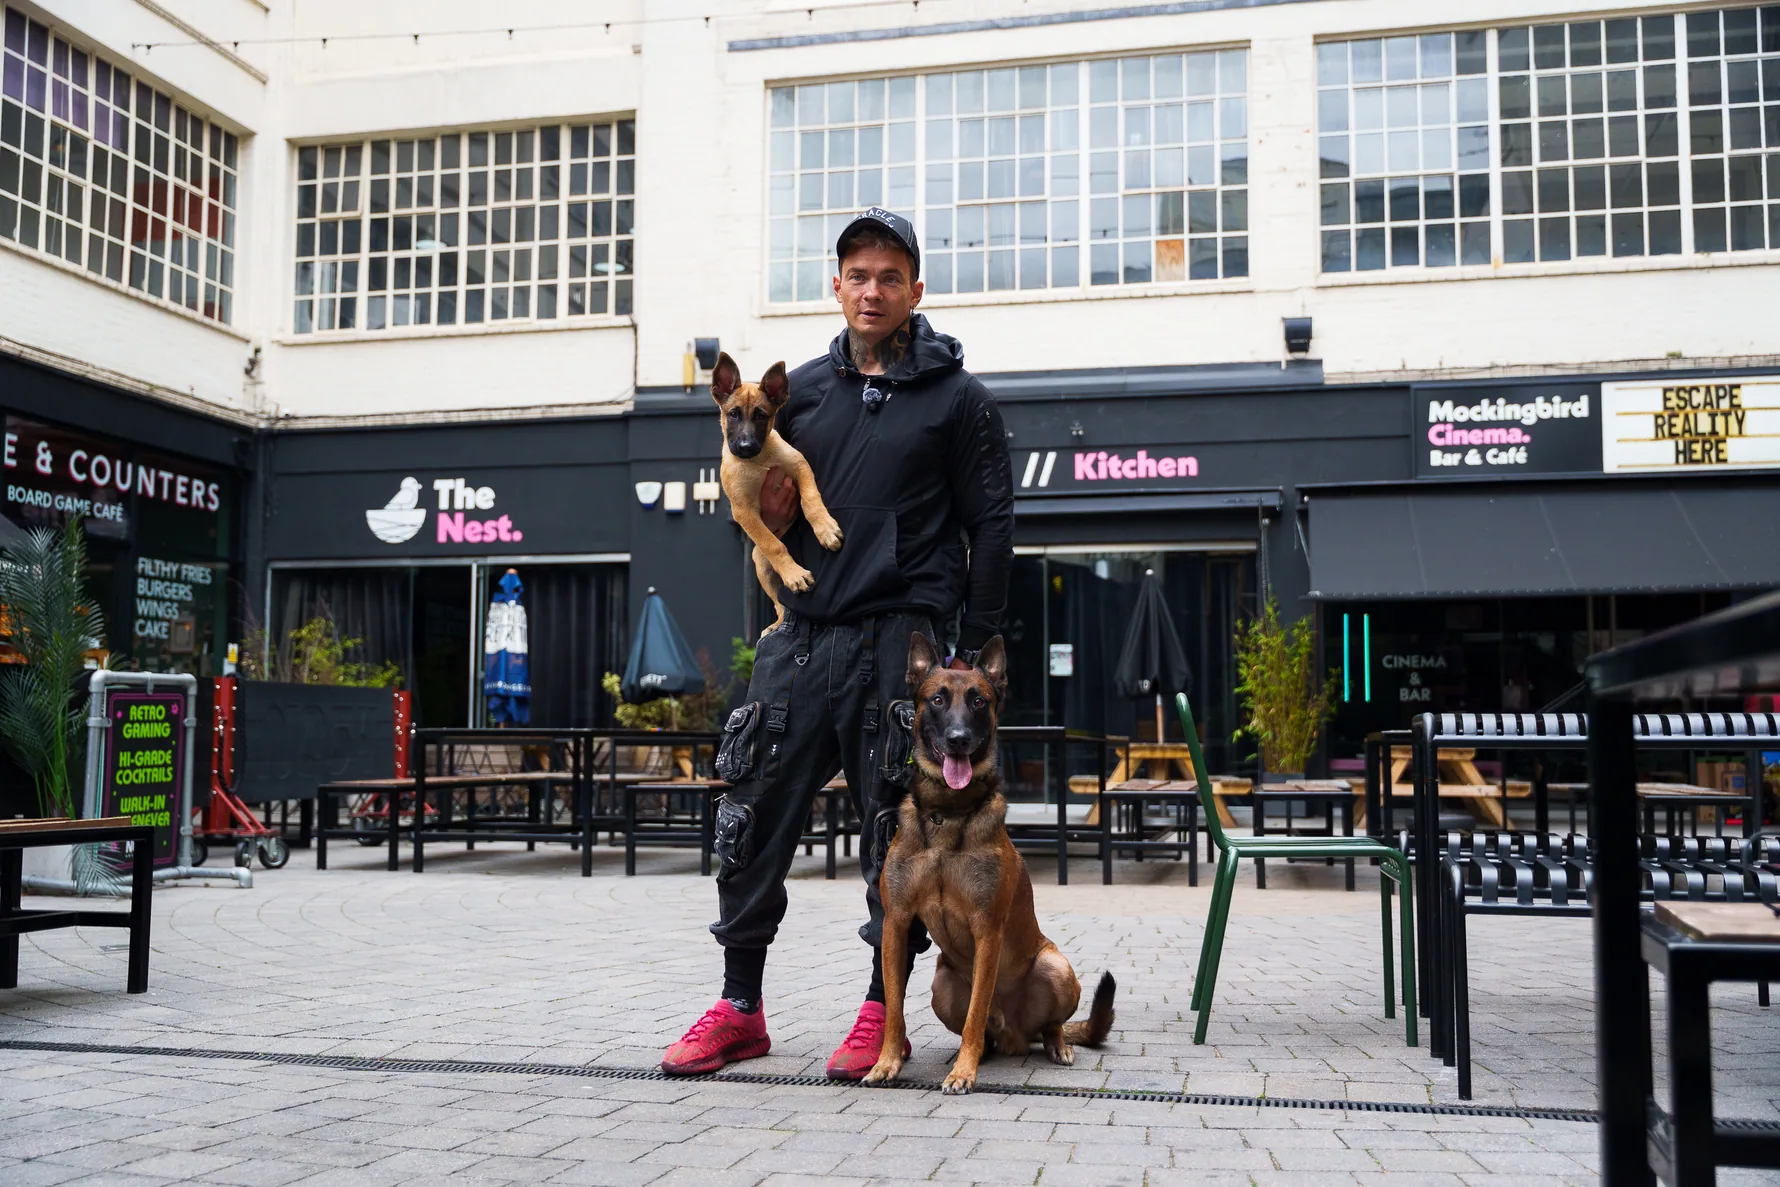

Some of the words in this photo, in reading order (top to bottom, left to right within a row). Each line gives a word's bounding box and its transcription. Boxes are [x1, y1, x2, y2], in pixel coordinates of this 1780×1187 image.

[859, 209, 896, 223] RACLE
[1662, 384, 1742, 410] ESCAPE
[1428, 394, 1590, 426] Mockingbird
[1654, 409, 1746, 438] REALITY
[1427, 423, 1531, 447] Cinema.
[1429, 449, 1462, 467] Bar
[1464, 449, 1483, 466] &
[1485, 445, 1528, 465] Café
[1674, 439, 1728, 465] HERE
[1074, 449, 1199, 480] Kitchen
[36, 440, 53, 475] &
[68, 449, 220, 512] COUNTERS
[7, 484, 53, 508] BOARD
[54, 495, 91, 516] GAME
[93, 502, 124, 523] CAFÉ
[433, 477, 496, 510] The
[436, 512, 523, 543] Nest.
[137, 556, 180, 579] FILTHY
[181, 563, 212, 585] FRIES
[137, 577, 193, 601] BURGERS
[136, 598, 180, 619] WINGS
[135, 619, 170, 639] CAKE
[1382, 655, 1446, 669] CINEMA
[1409, 671, 1421, 686] &
[1400, 687, 1431, 701] BAR
[129, 705, 166, 721] RETRO
[122, 721, 171, 739] GAMING
[118, 751, 172, 768] HI-GRADE
[115, 767, 173, 785] COCKTAILS
[120, 795, 166, 813] WALK-IN
[131, 813, 171, 826] ENEVER
